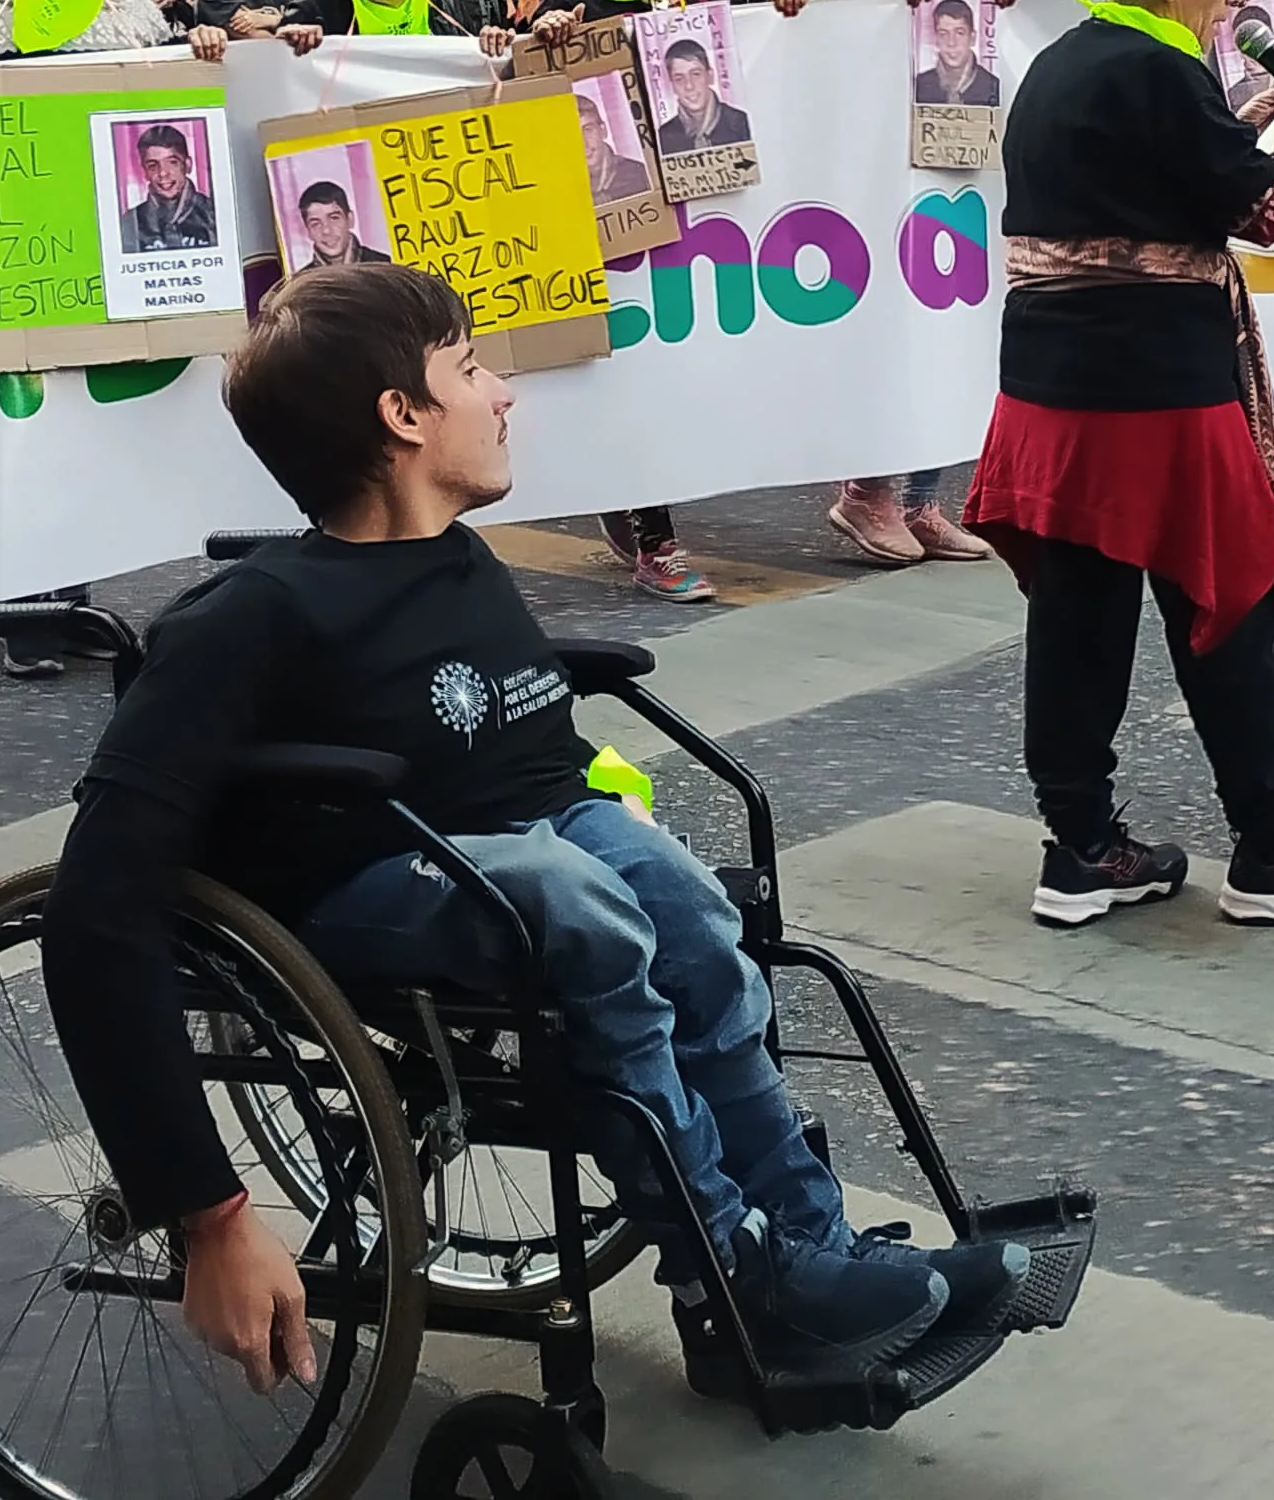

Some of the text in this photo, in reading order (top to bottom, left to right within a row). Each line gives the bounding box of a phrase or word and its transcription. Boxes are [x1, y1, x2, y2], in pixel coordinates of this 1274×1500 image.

[0, 102, 38, 135] EL
[917, 106, 973, 122] FISCAL
[381, 114, 513, 166] QUE EL
[921, 122, 972, 143] RAUL
[921, 146, 989, 167] GARZON
[383, 153, 537, 218] FISCAL
[393, 211, 485, 260] RAUL
[897, 186, 989, 310] a
[121, 256, 224, 274] JUSTICIA POR
[144, 275, 203, 289] MATIAS
[144, 292, 206, 308] MARIÑO
[506, 710, 513, 723] A
[512, 705, 523, 720] LA
[523, 694, 548, 715] SALUD
